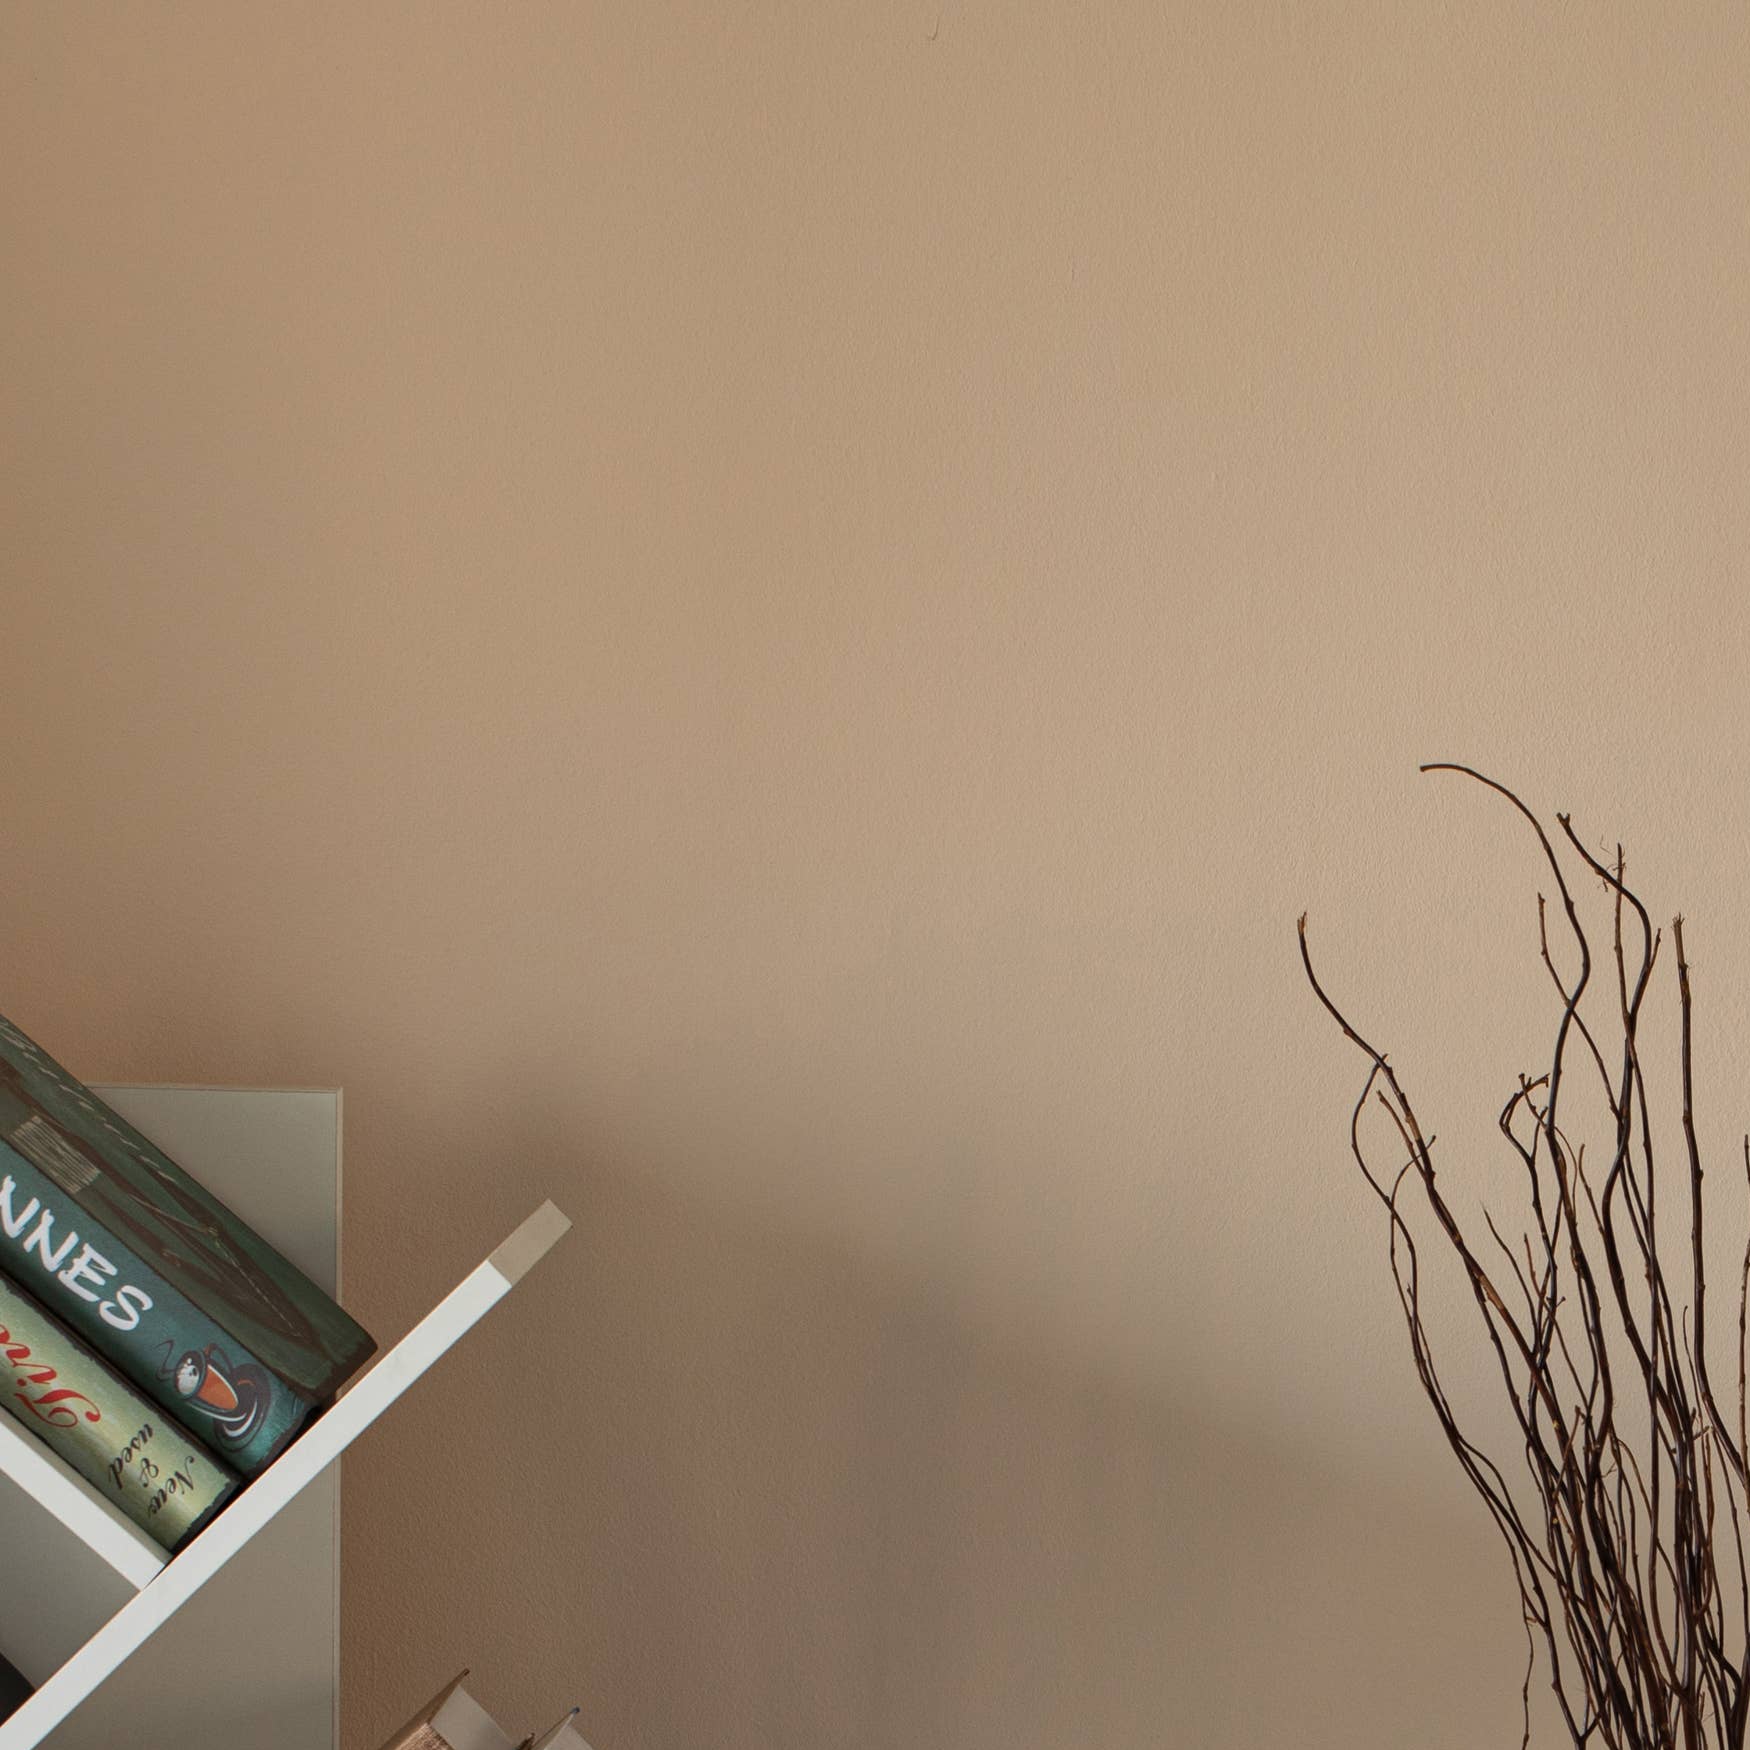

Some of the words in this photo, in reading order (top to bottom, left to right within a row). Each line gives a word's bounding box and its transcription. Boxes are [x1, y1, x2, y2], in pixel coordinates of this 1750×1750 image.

[108, 1424, 153, 1490] used
[139, 1458, 159, 1488] &
[148, 1456, 195, 1514] New
